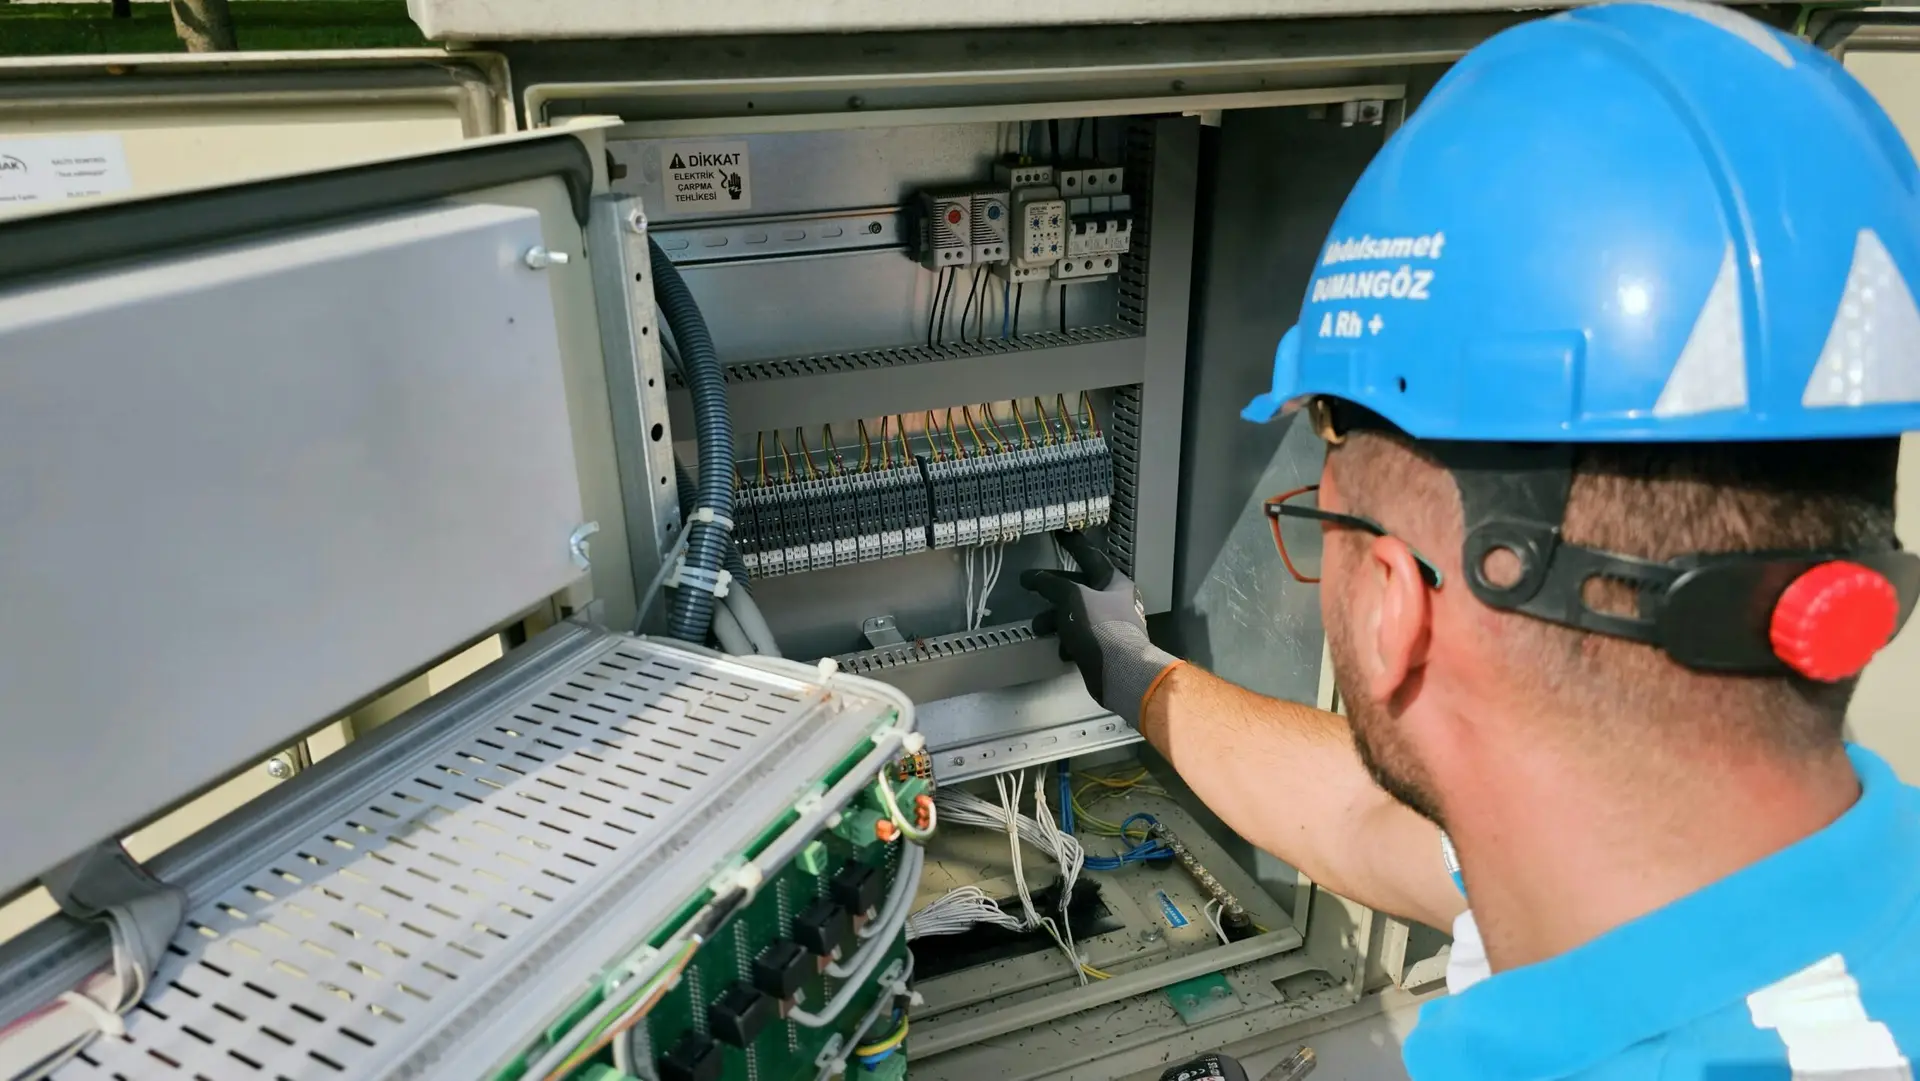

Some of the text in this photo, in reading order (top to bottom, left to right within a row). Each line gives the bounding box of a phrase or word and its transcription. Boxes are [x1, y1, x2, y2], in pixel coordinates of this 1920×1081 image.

[688, 152, 741, 167] DİKKAT
[674, 170, 715, 181] ELEKTRİK
[677, 182, 713, 192] ÇARPMA
[675, 192, 717, 202] TEHLİKESİ
[1311, 264, 1434, 303] DUMANGÖZ
[1318, 312, 1332, 337] A
[1334, 310, 1362, 337] Rh
